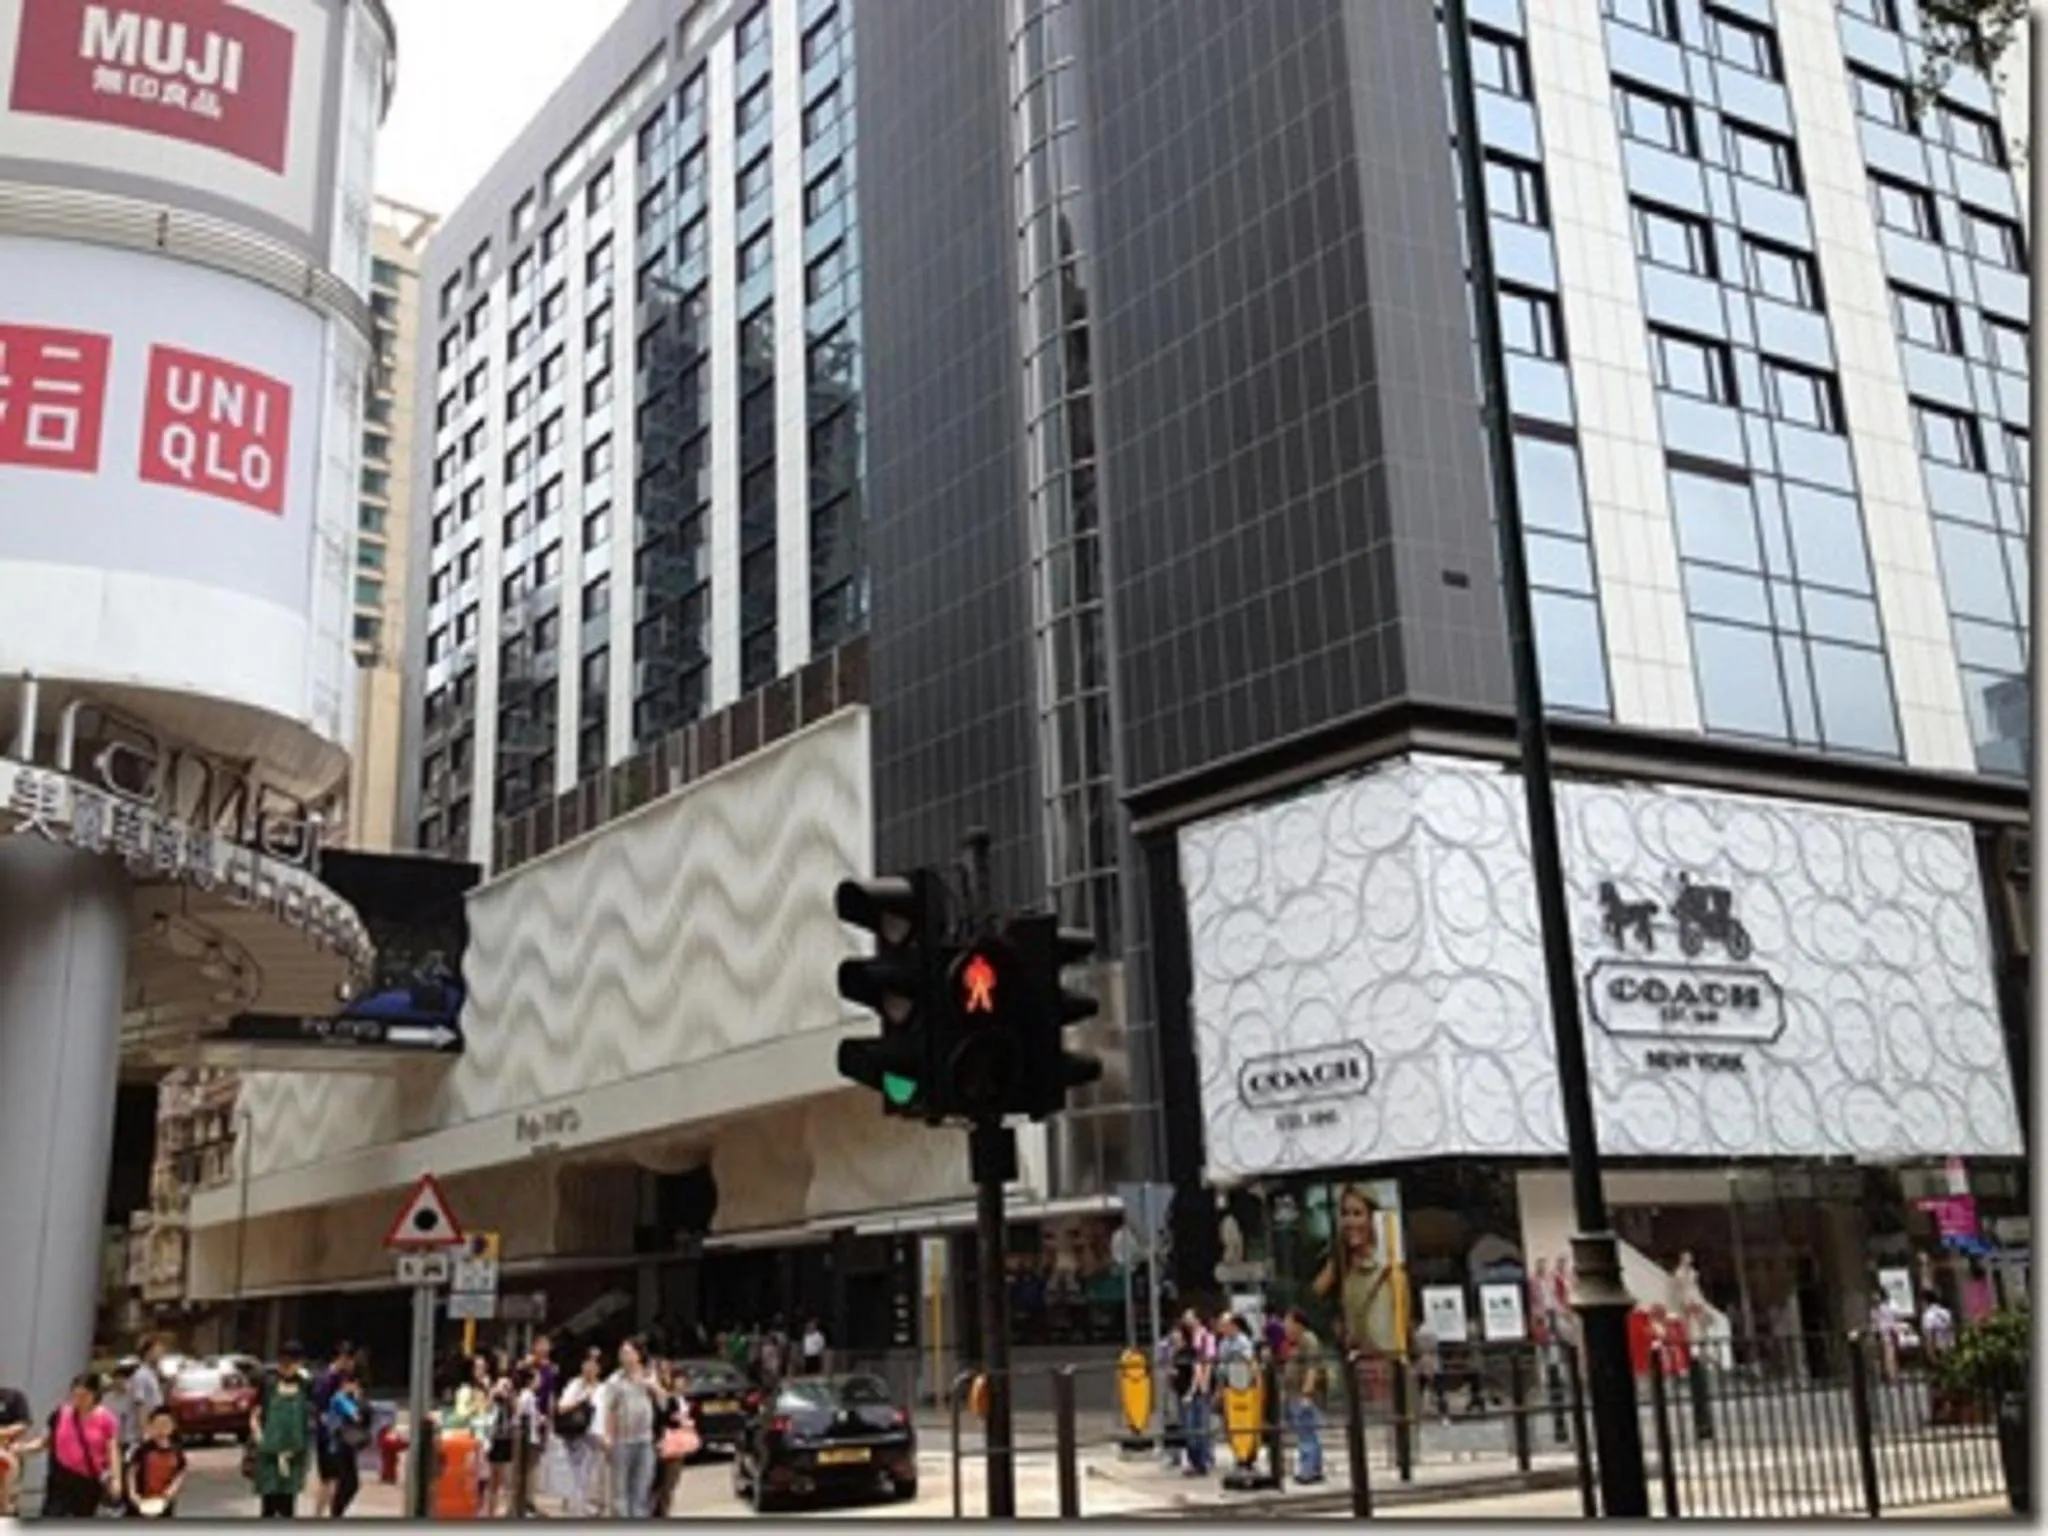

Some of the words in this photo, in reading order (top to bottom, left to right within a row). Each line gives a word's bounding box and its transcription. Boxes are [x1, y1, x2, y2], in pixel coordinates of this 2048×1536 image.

[79, 5, 243, 95] MUJI
[166, 365, 268, 438] UNI
[160, 421, 272, 492] QLO
[1606, 976, 1760, 1009] COACH
[1248, 1058, 1361, 1095] COACH
[1646, 1050, 1691, 1070] NEW
